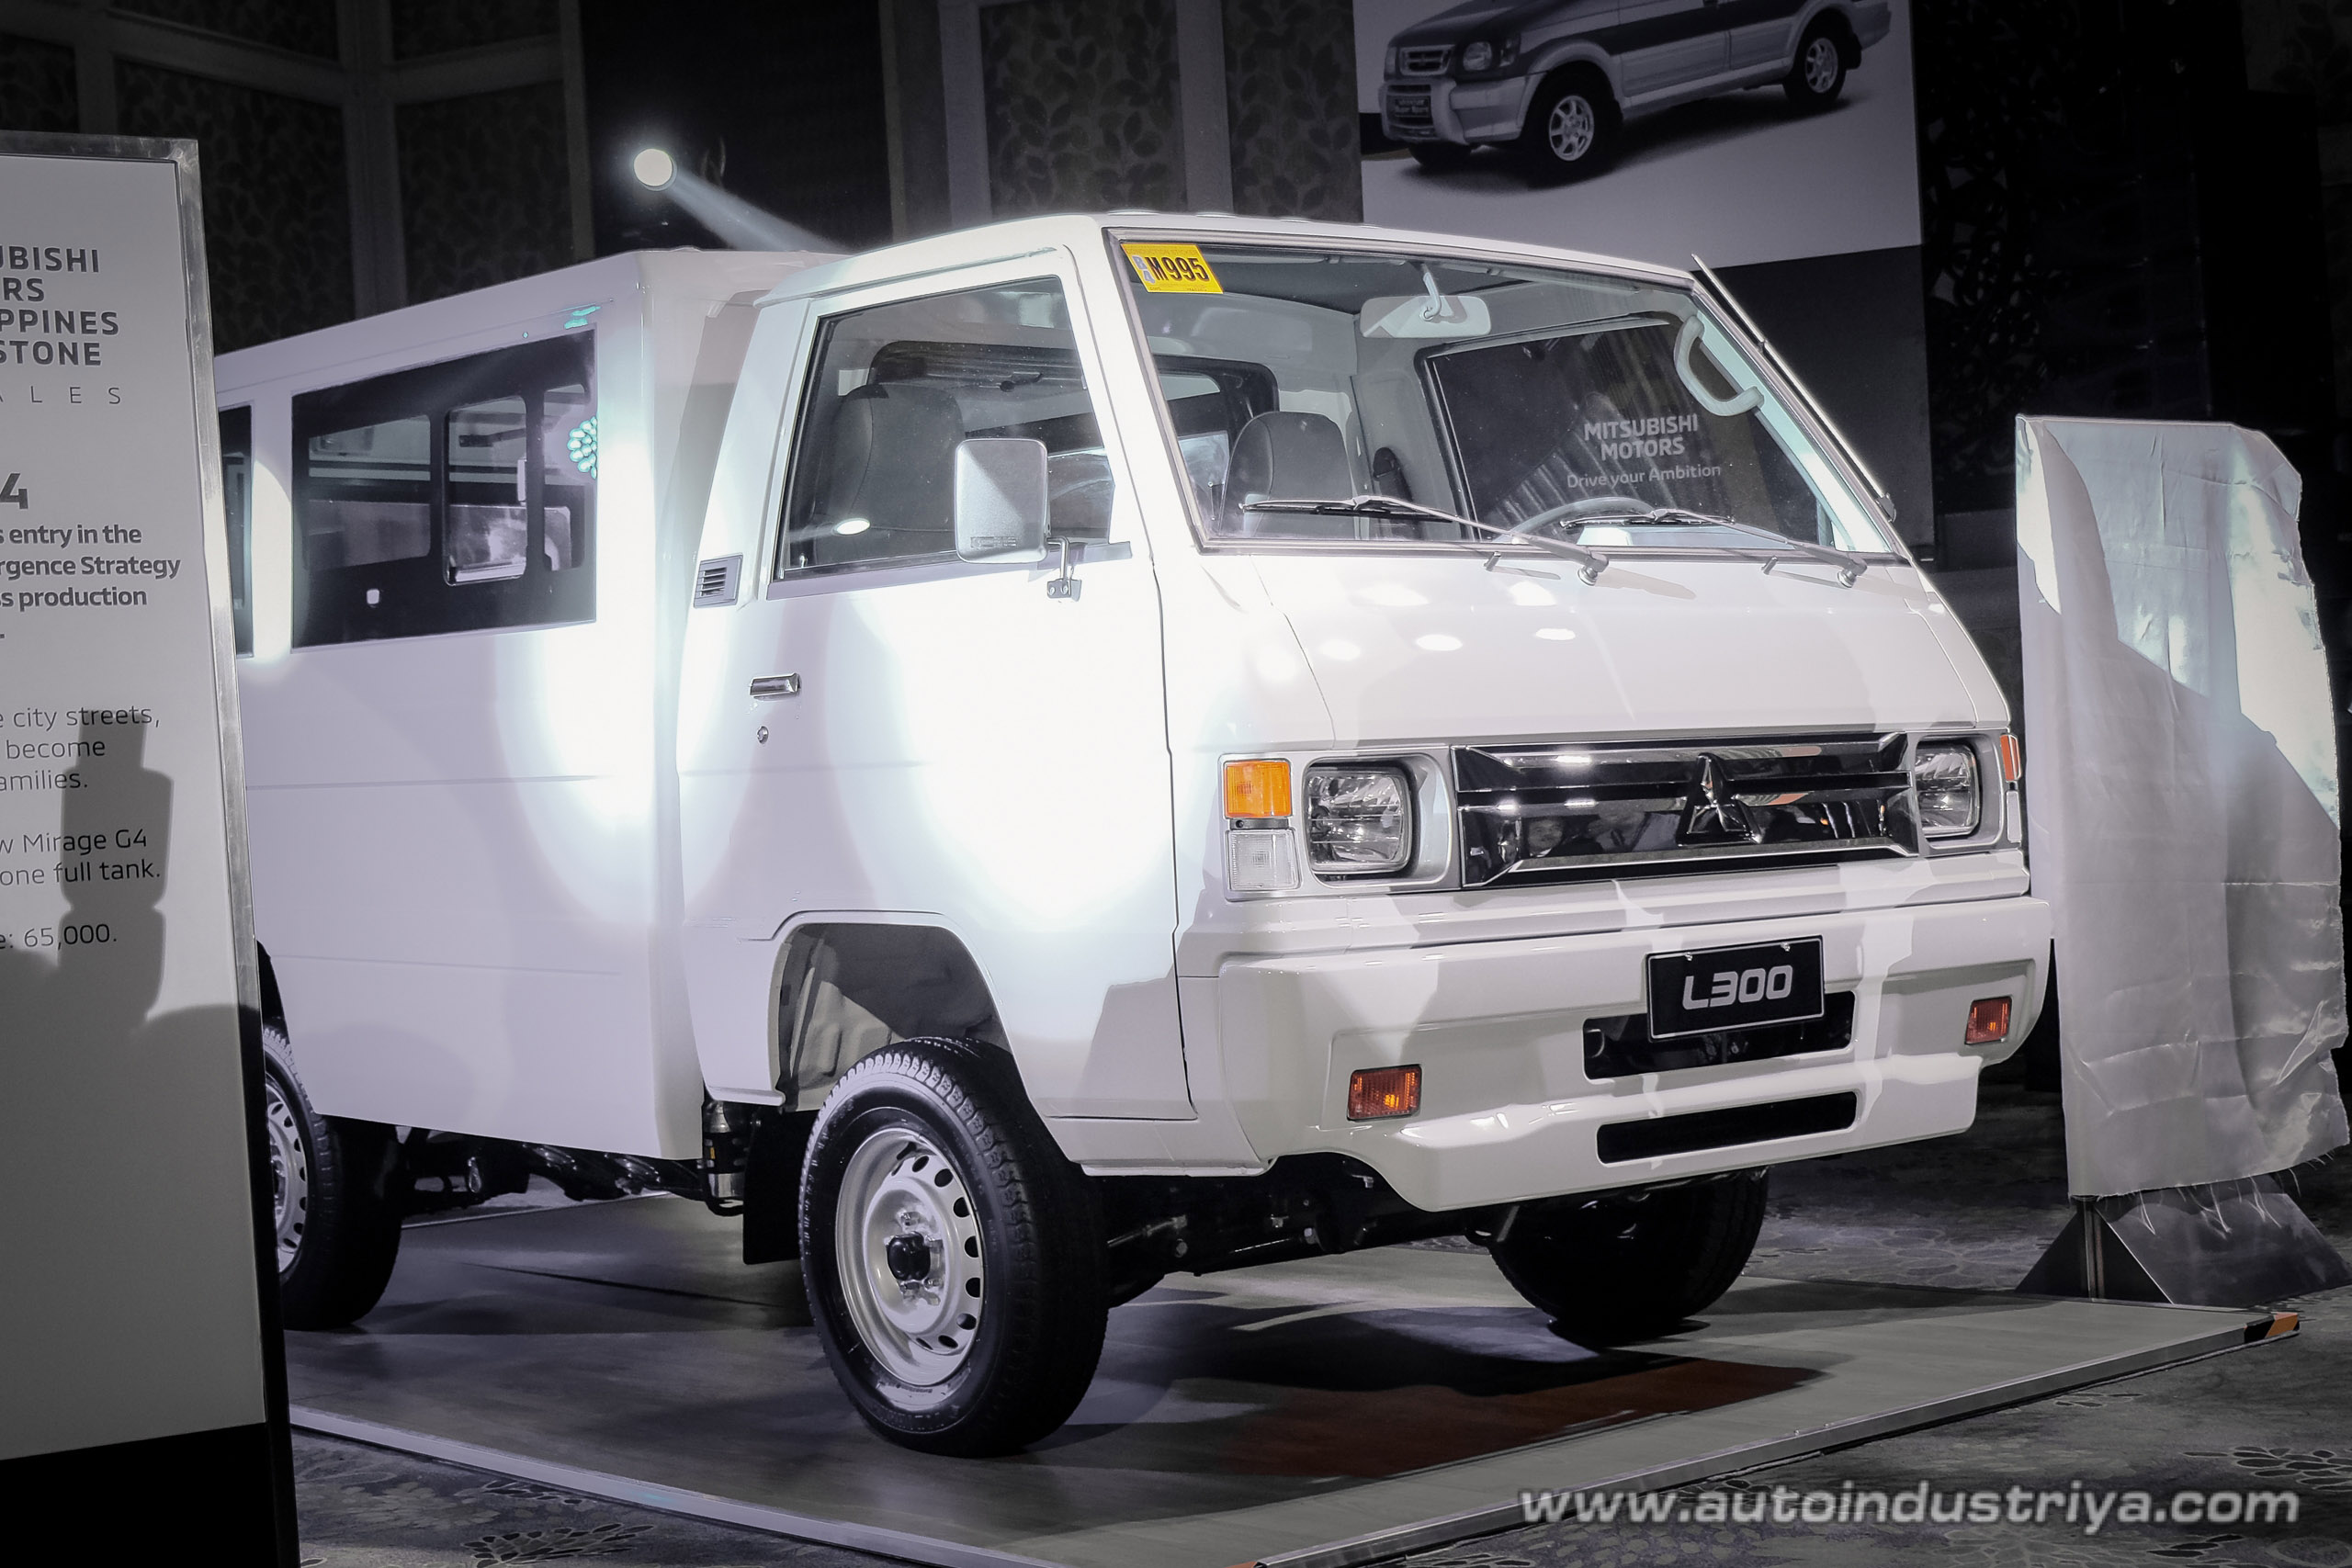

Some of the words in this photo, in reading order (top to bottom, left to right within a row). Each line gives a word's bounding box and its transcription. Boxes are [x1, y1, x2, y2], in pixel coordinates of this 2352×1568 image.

[0, 245, 99, 273] BISHI
[1144, 256, 1210, 282] M995
[3, 276, 45, 302] RS
[0, 309, 119, 335] PPINES
[0, 386, 121, 405] LES
[1583, 413, 1699, 441] MITSUBISHI
[1600, 436, 1685, 461] MOTORS
[1566, 473, 1607, 489] Drive
[1608, 471, 1645, 490] your
[1648, 463, 1721, 482] Ambition
[9, 525, 73, 548] entry
[77, 524, 98, 544] in
[102, 524, 141, 544] the
[80, 556, 181, 580] Strategy
[18, 586, 147, 612] production
[13, 707, 57, 731] city
[66, 705, 160, 728] streets,
[6, 739, 106, 760] become
[23, 832, 107, 856] Mirage
[116, 829, 147, 849] G4
[0, 867, 45, 886] one
[53, 862, 91, 883] full
[99, 859, 161, 881] tank.
[24, 923, 118, 951] 65,000.
[1682, 964, 1793, 1010] L300
